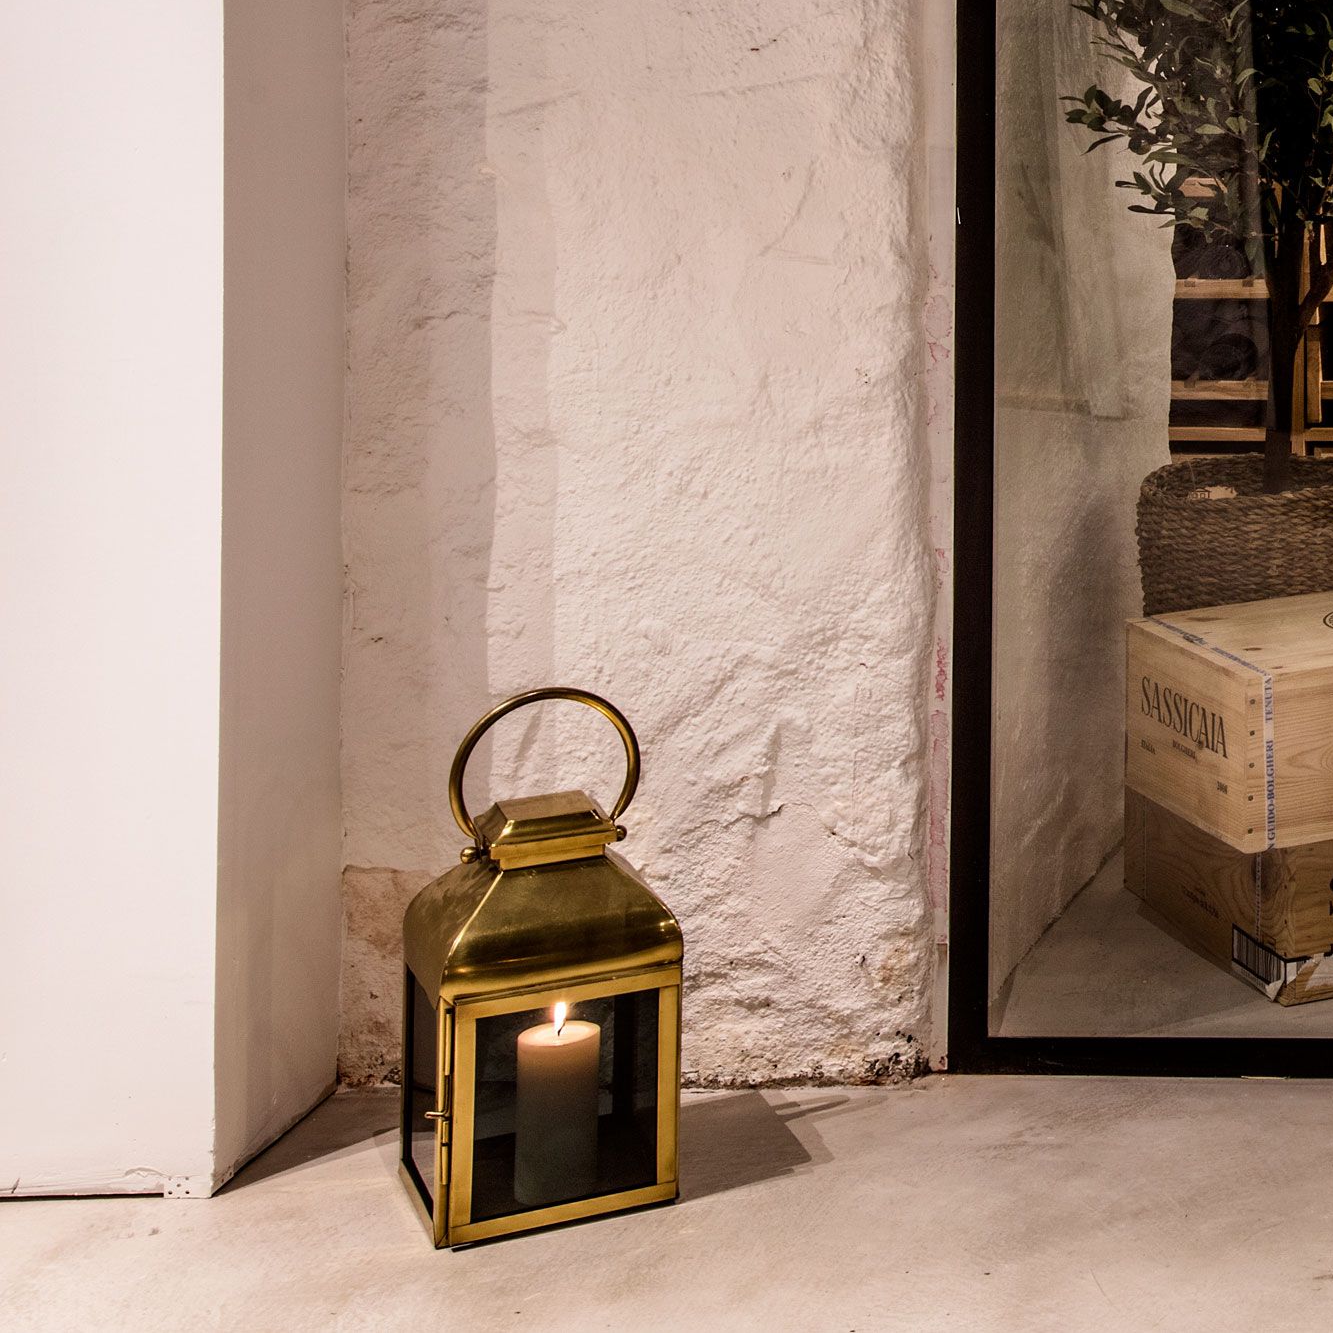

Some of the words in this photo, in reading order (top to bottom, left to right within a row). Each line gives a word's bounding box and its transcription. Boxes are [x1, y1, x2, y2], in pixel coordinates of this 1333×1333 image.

[1141, 676, 1228, 759] SASSICAIA
[1264, 677, 1273, 723] TENUTA
[1265, 739, 1275, 841] GUIDO-BOLGHERI
